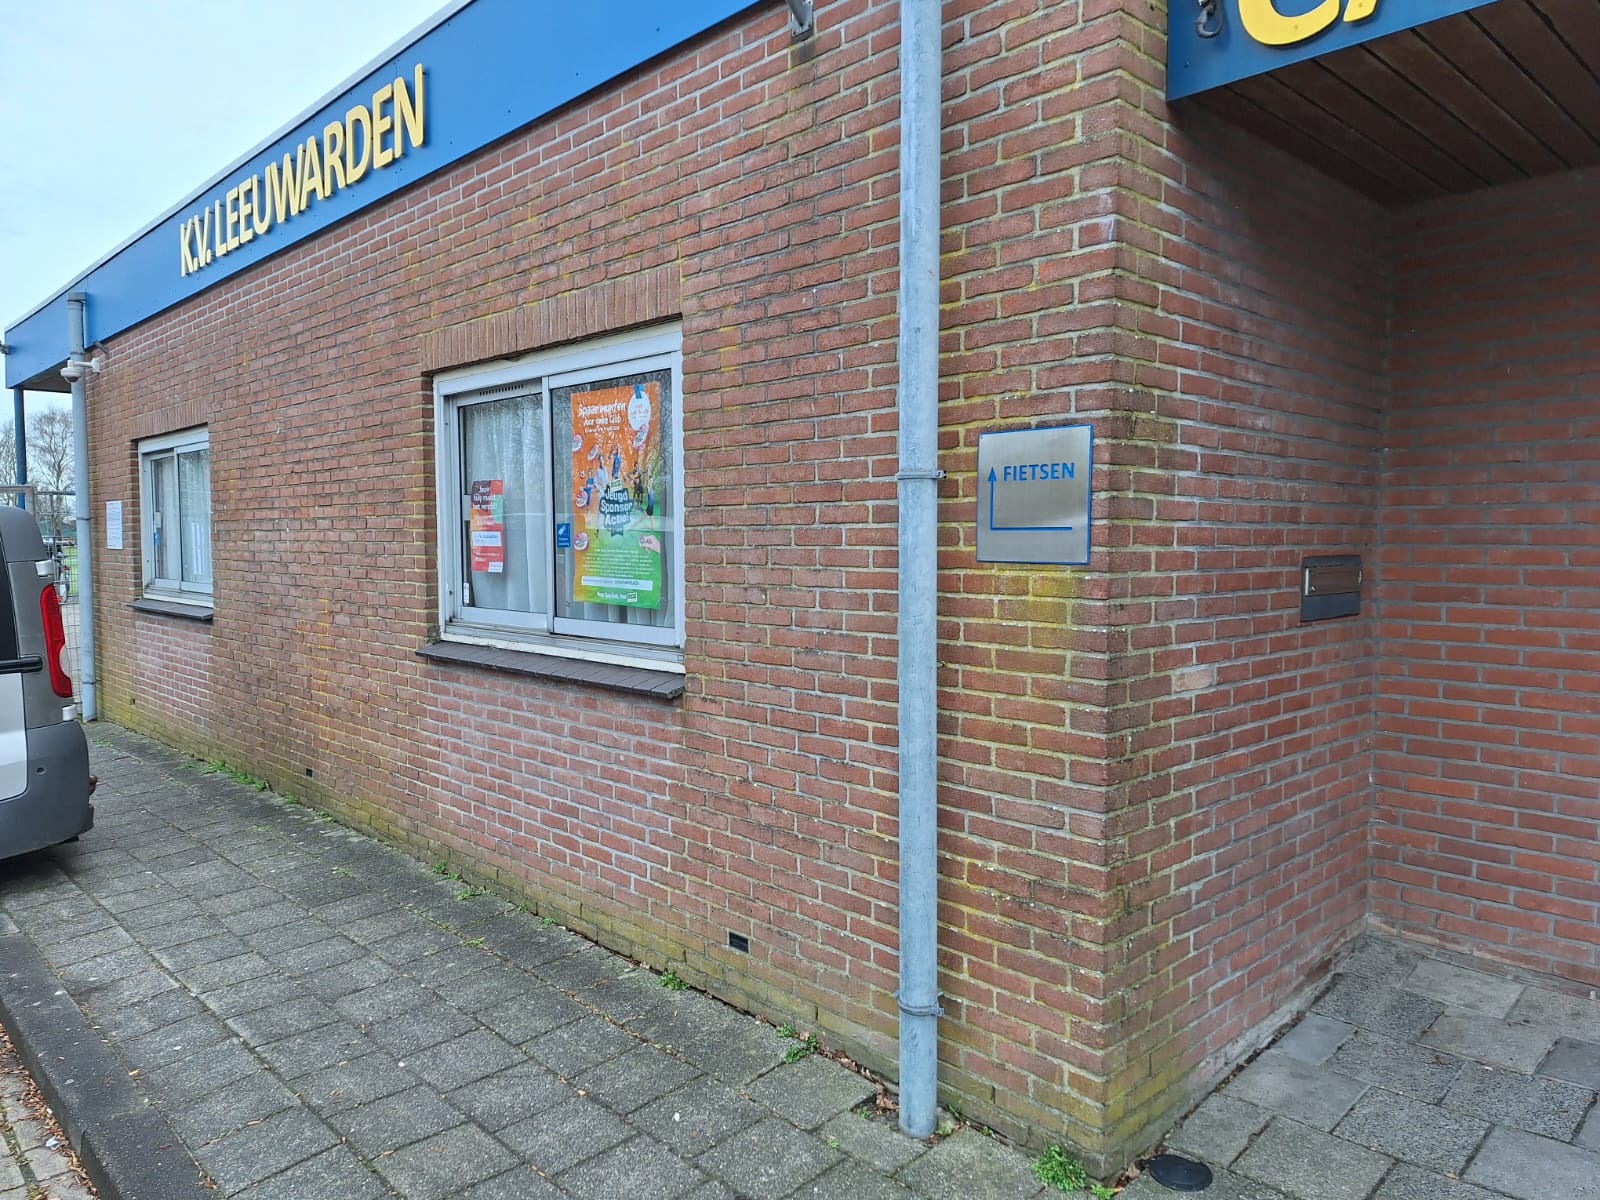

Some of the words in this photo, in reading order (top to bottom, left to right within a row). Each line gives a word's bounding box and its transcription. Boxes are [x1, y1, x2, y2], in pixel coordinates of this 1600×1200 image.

[215, 63, 424, 257] LEEUWARDEN
[1003, 462, 1075, 482] FIETSEN
[605, 487, 628, 502] Jeugd
[600, 500, 633, 514] Sponsor
